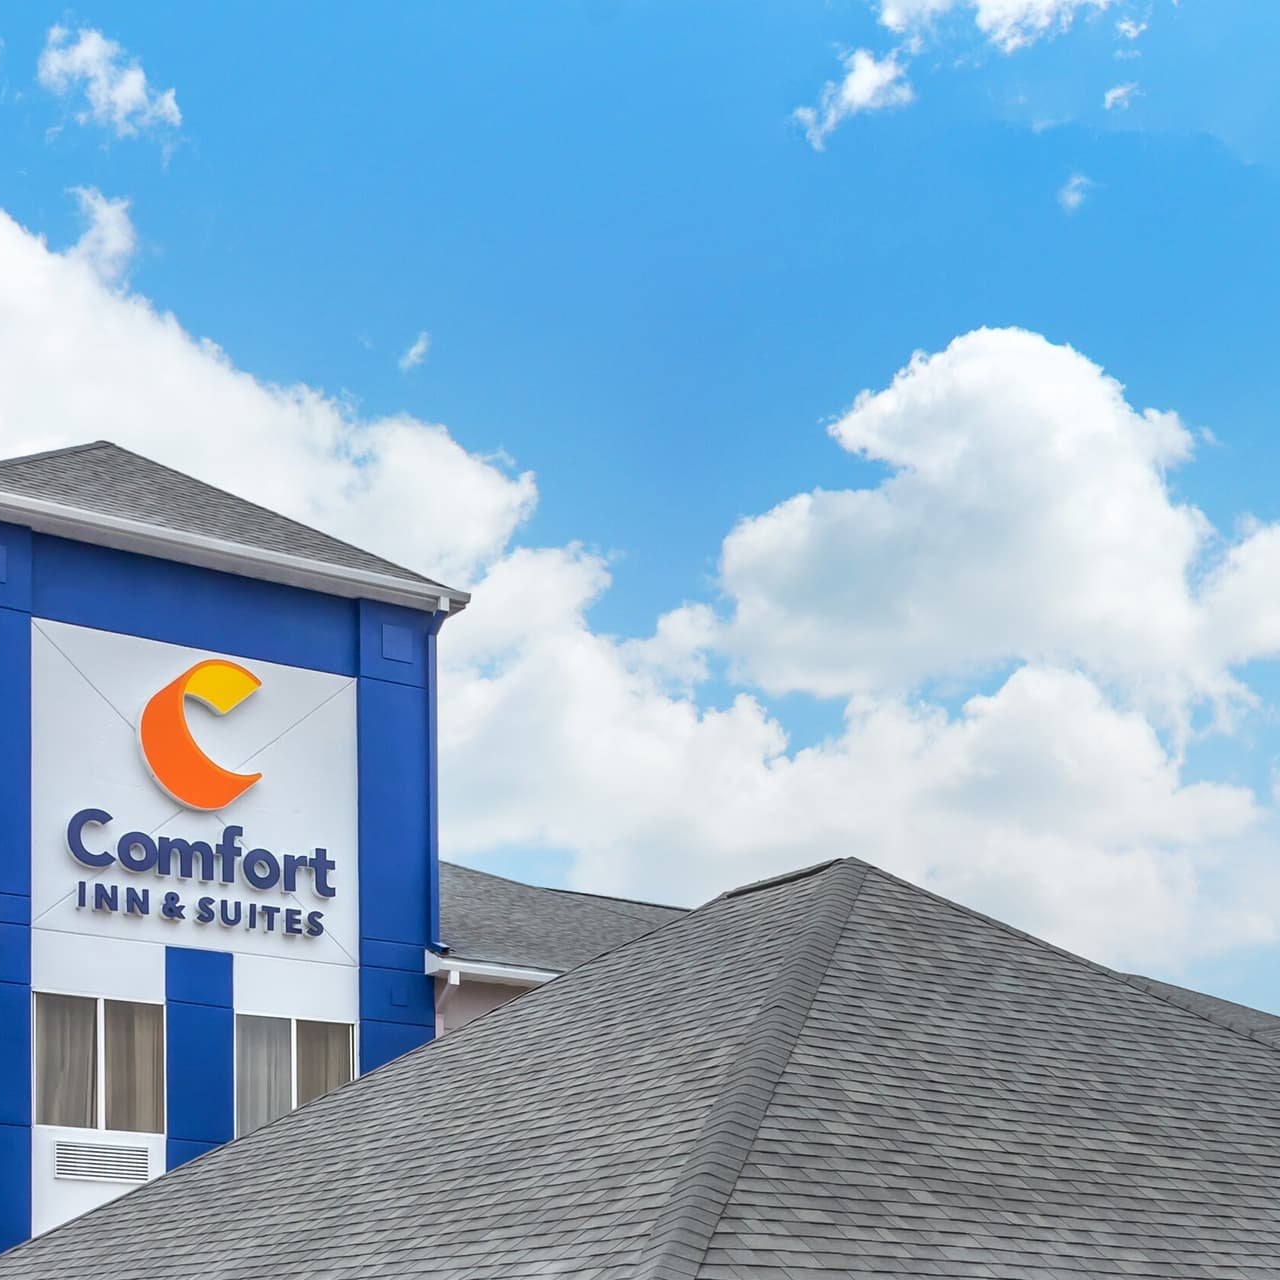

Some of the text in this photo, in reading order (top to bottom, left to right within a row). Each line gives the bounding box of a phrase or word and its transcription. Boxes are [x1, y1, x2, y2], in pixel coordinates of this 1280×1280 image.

[67, 808, 336, 899] Comfort
[77, 881, 325, 937] INN & SUITES
